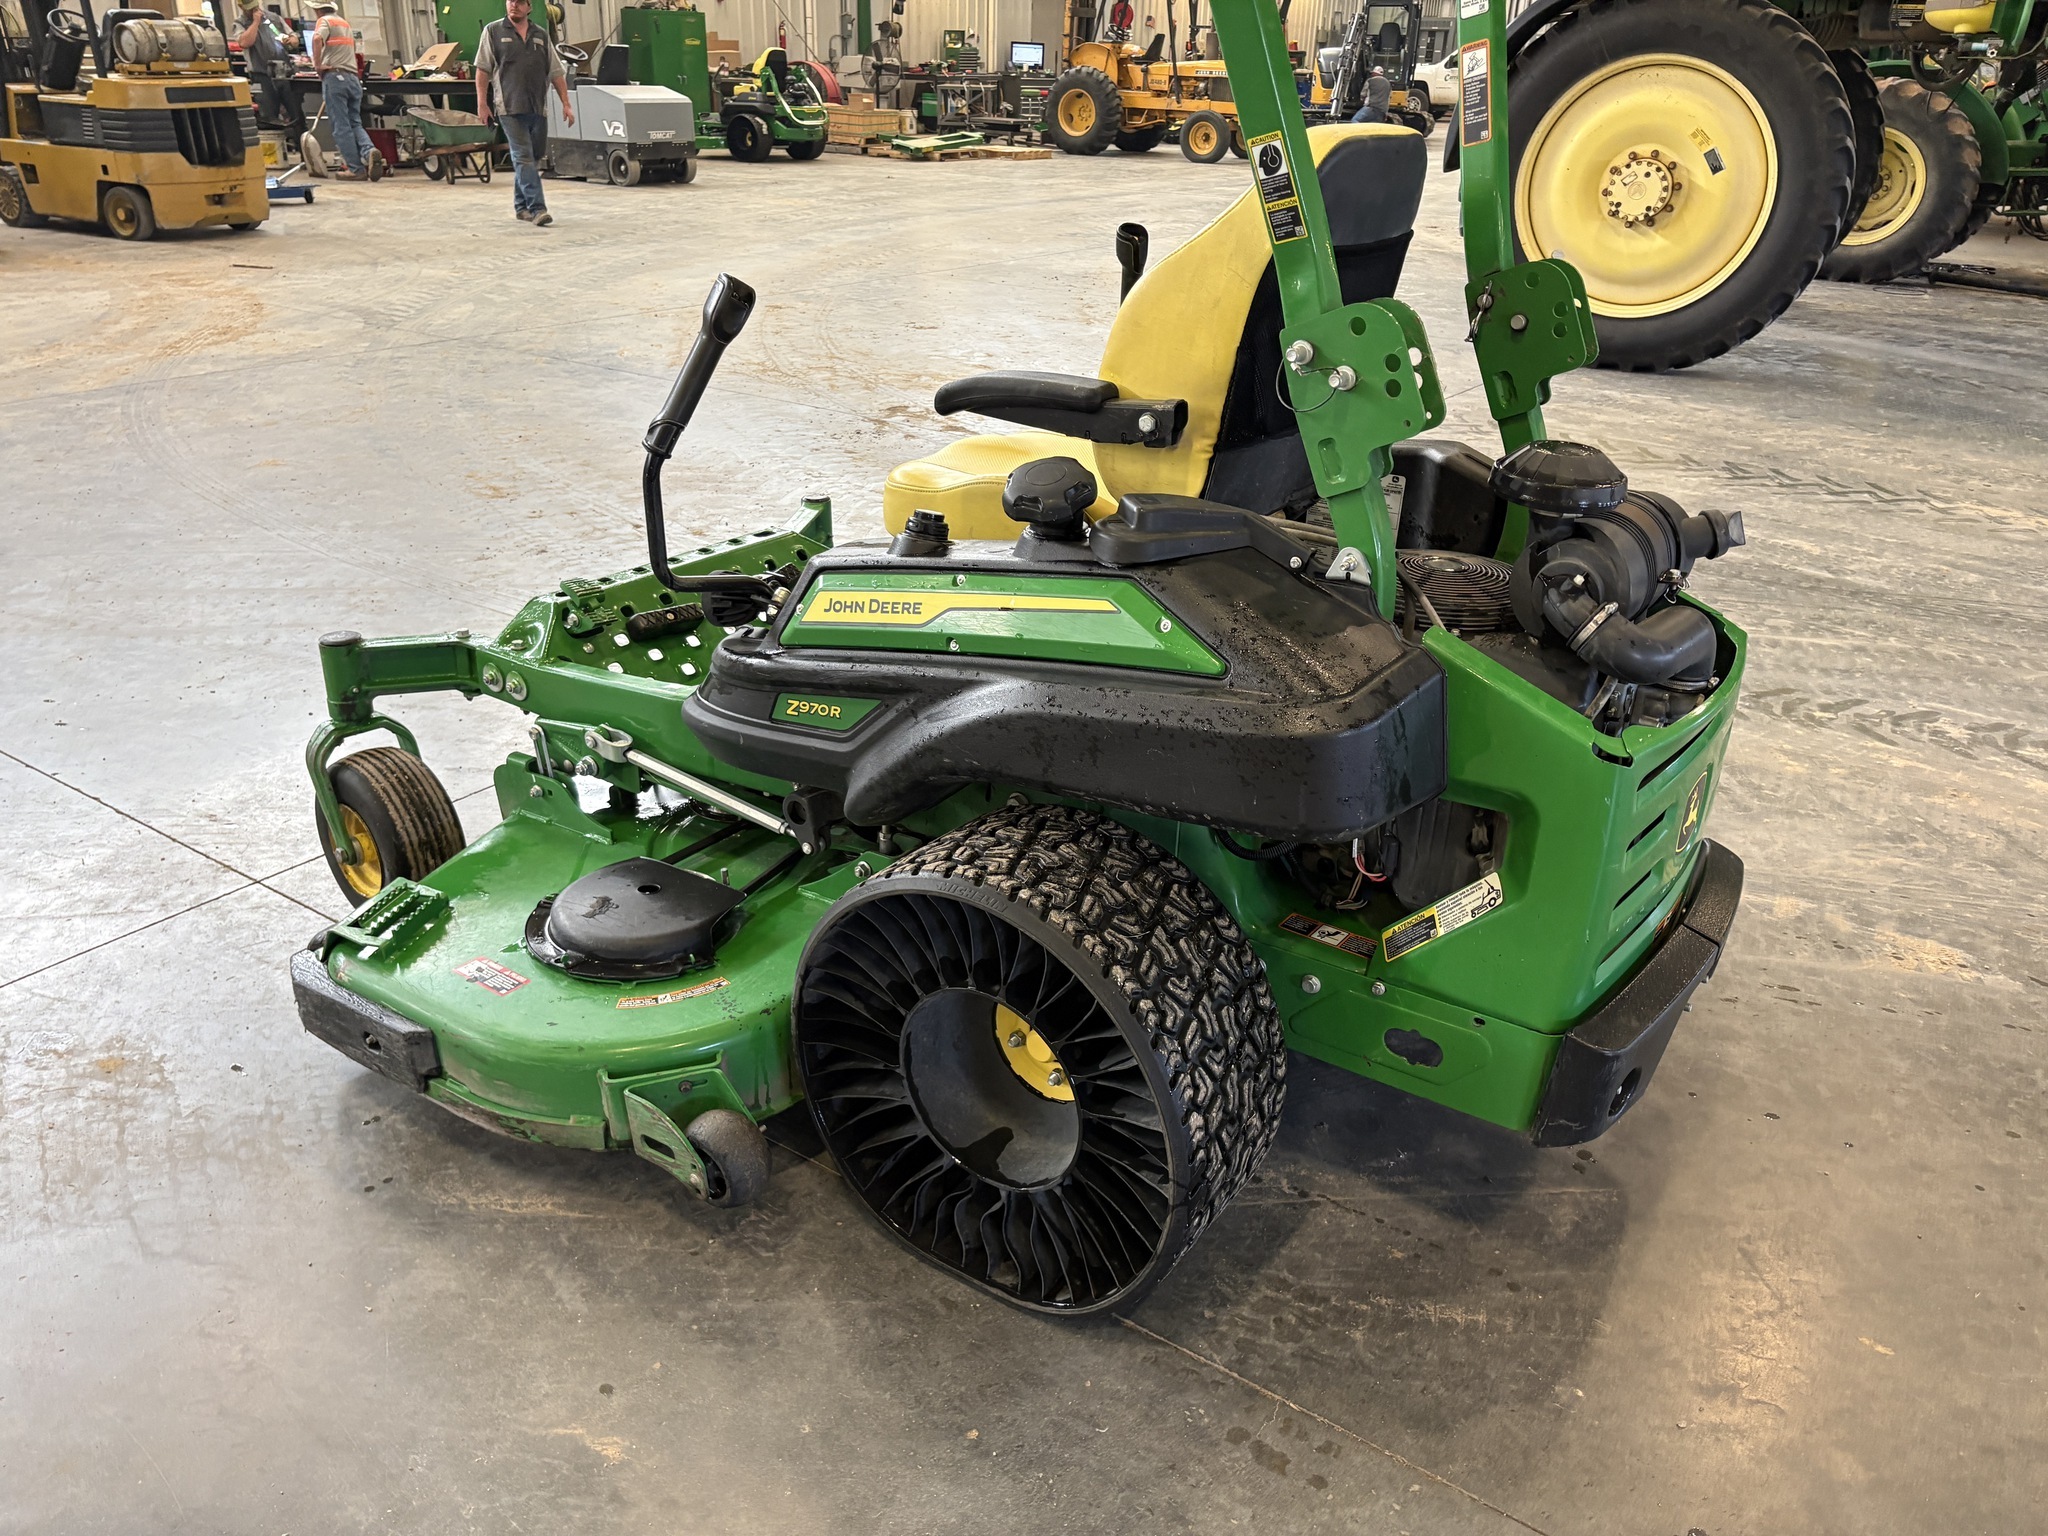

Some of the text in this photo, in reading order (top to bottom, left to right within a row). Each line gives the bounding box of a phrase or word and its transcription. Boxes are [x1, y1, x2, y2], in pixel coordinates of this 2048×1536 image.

[602, 120, 626, 138] VR
[647, 131, 676, 140] TOMCAT
[1254, 132, 1279, 146] CAUTION
[1270, 199, 1298, 209] ATENCIÓN
[823, 598, 922, 615] JOHN DEERE
[786, 699, 841, 719] Z970R
[1396, 912, 1426, 932] ATENCIÓN
